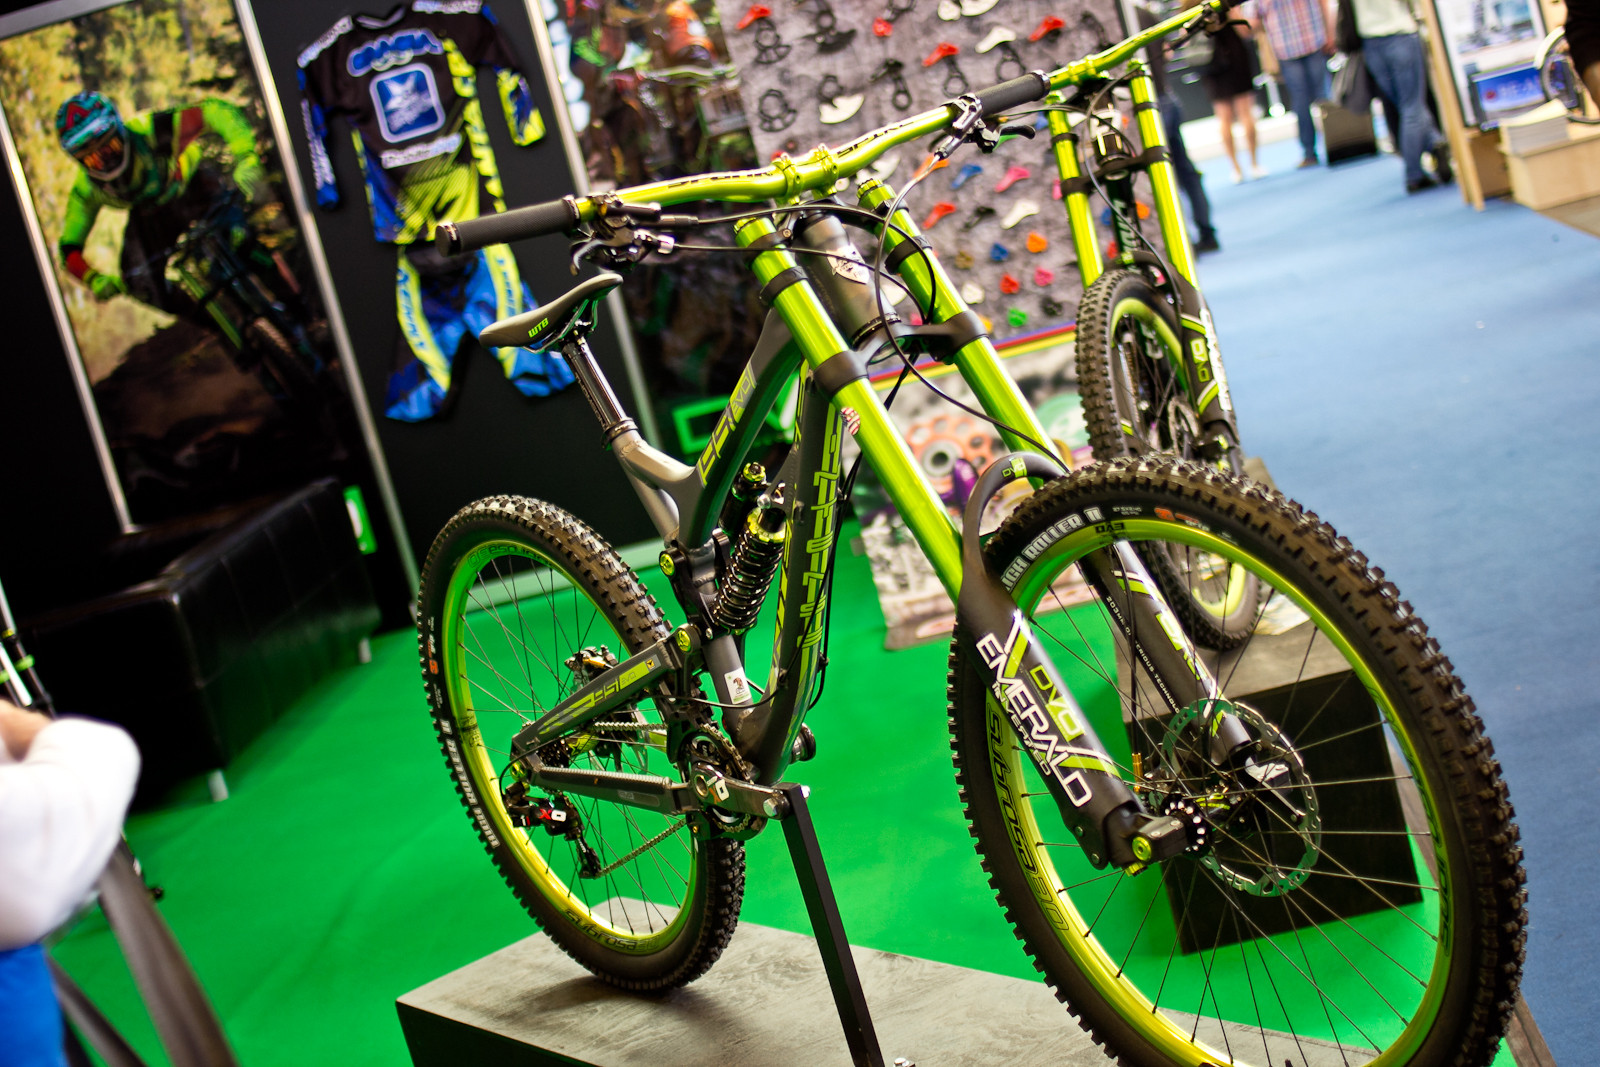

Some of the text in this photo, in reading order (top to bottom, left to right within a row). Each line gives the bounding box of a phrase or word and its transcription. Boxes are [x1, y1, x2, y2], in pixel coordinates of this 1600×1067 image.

[528, 318, 549, 338] WTB
[1002, 459, 1026, 477] DVO
[1021, 513, 1084, 561] ROLLER
[1095, 522, 1125, 535] EVO
[976, 633, 1092, 807] EMERALD
[1030, 665, 1081, 736] DVO
[987, 703, 1038, 876] subrosa
[563, 908, 638, 951] subrosa
